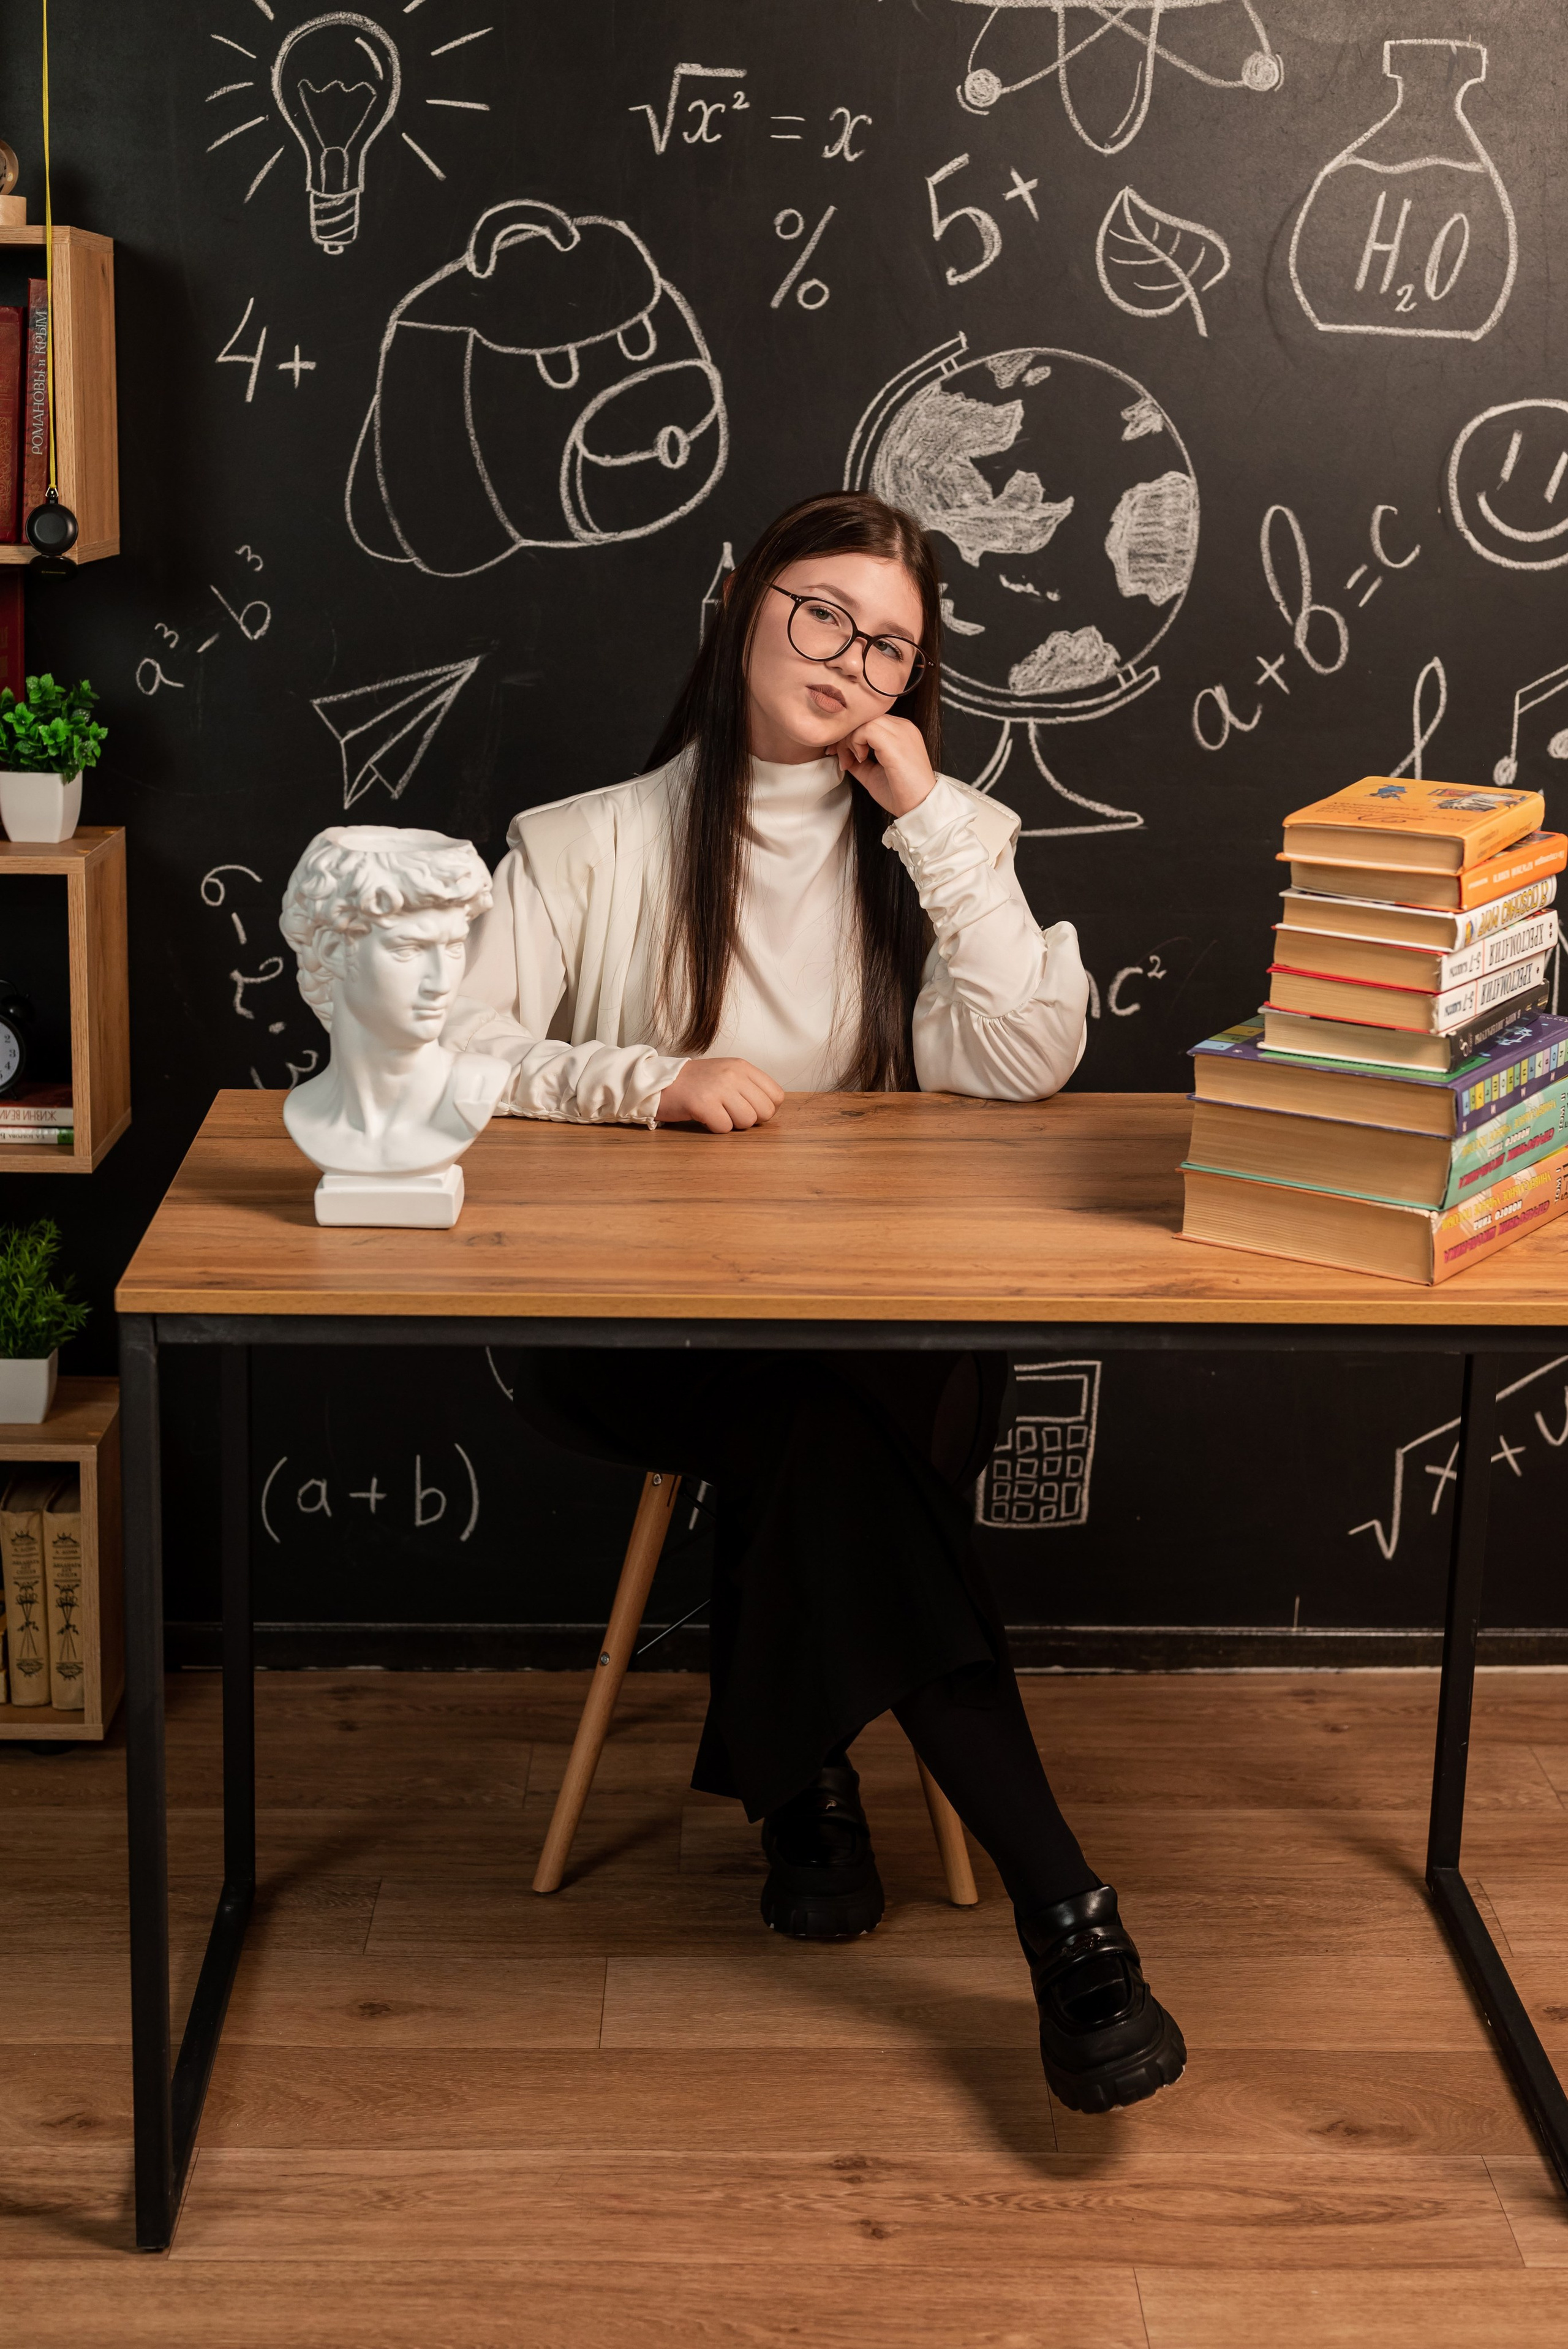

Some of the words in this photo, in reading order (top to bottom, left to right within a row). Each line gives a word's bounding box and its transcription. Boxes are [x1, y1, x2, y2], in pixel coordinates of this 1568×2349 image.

[770, 205, 838, 308] %
[35, 311, 47, 355] КРЫМ
[31, 371, 45, 455] РОМАНОВЫ
[1501, 885, 1539, 925] ПОЗНАЮ
[1539, 880, 1549, 907] Я
[1477, 905, 1499, 937] МИР
[1489, 923, 1545, 966] ХРЕСТОМАТИЯ
[1480, 963, 1533, 1005] ХРЕСТОМАТИЯ
[4, 1034, 11, 1044] 2
[9, 1048, 17, 1058] 3
[4, 1061, 12, 1070] 4
[23, 1109, 57, 1121] ЖИЗНИ
[1487, 1140, 1504, 1158] ТИПА
[1504, 1125, 1531, 1147] НОВОГО
[1506, 1127, 1555, 1163] СПРАВОЧНИК
[1458, 1152, 1506, 1190] ШКОЛЬНИКА
[1502, 1170, 1551, 1203] УНИВЕРСАЛЬНОЕ
[1474, 1194, 1501, 1216] УЧЕБНОЕ
[1494, 1199, 1523, 1221] НОВОГО
[1497, 1200, 1550, 1236] СПРАВОЧНИК
[1473, 1214, 1492, 1231] ТИПА
[1444, 1225, 1497, 1264] ШКОЛЬНИКА
